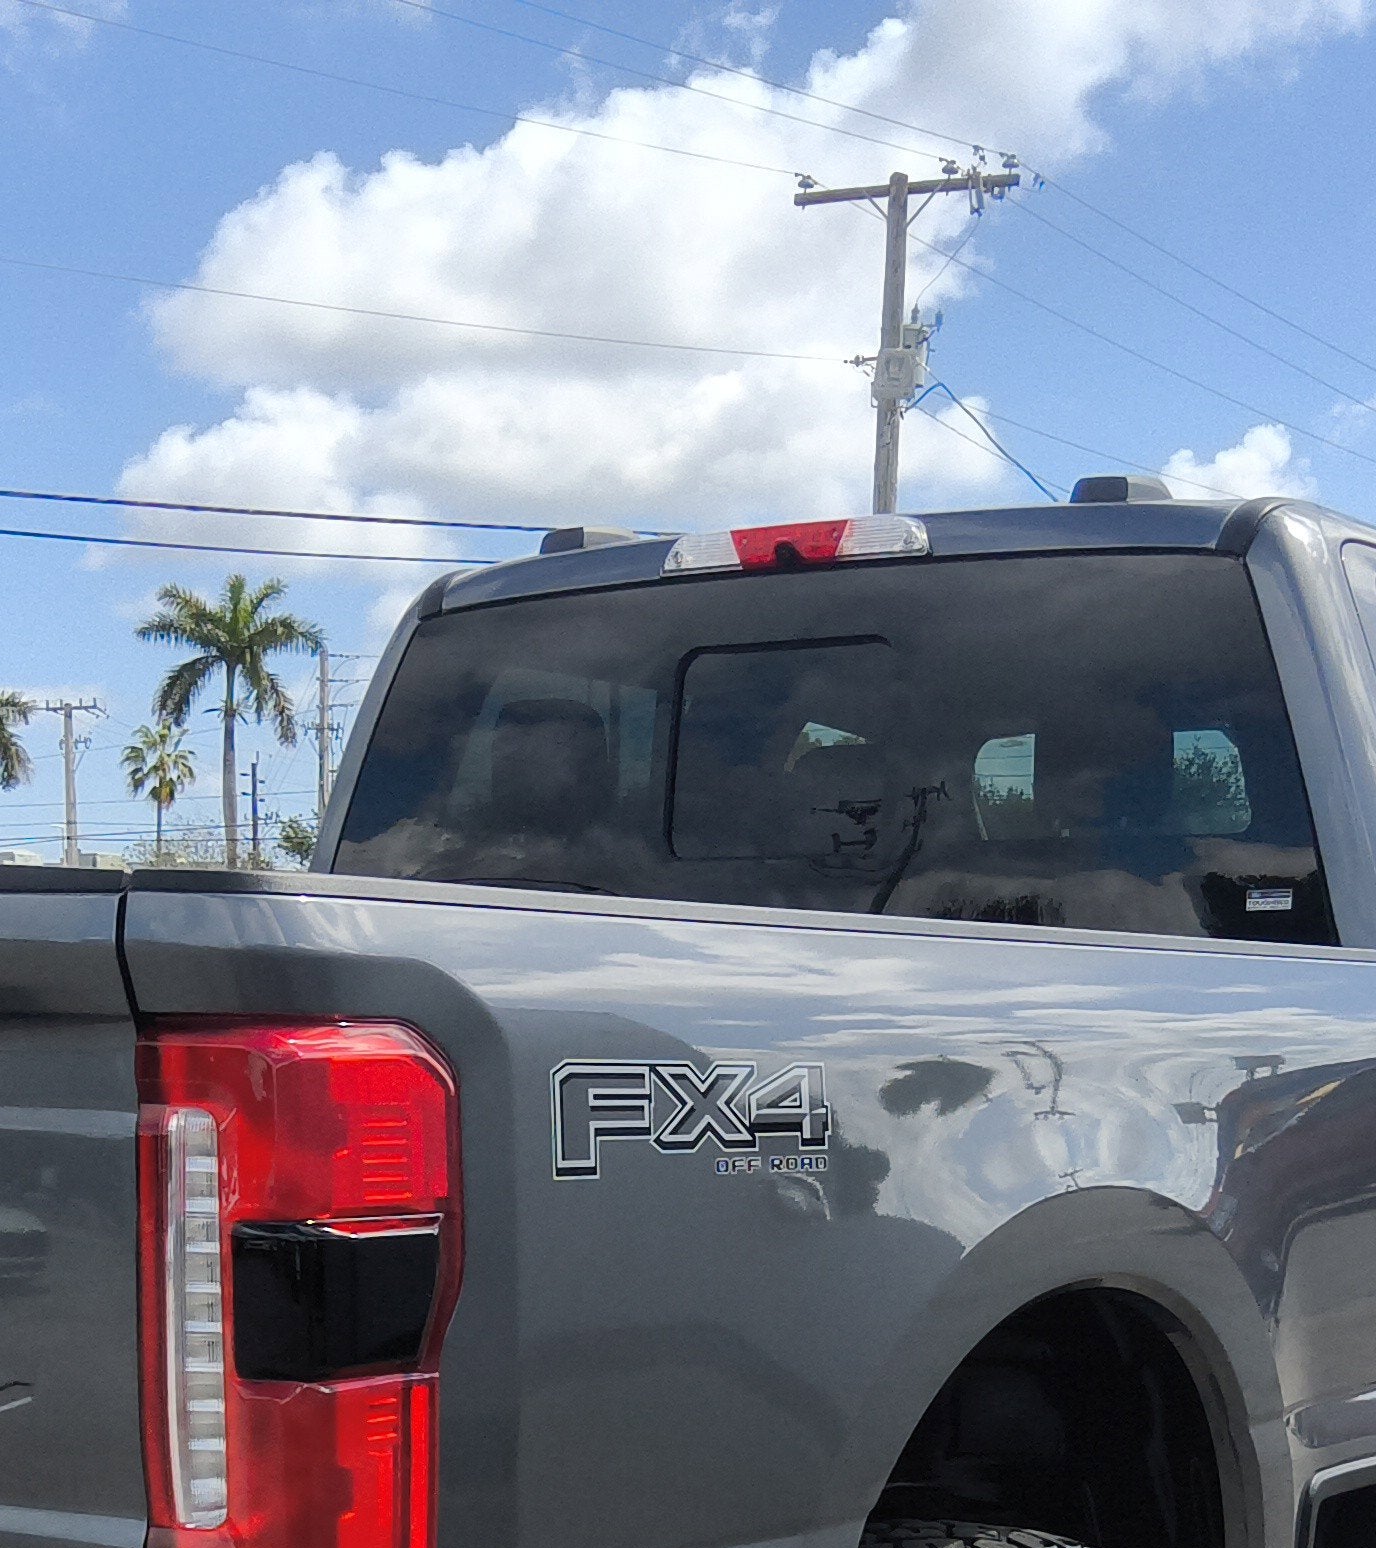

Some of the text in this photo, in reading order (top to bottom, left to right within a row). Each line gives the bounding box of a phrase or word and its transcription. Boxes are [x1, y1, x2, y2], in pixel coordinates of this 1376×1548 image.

[549, 1058, 832, 1181] FX4
[715, 1155, 828, 1174] OFF ROAD
